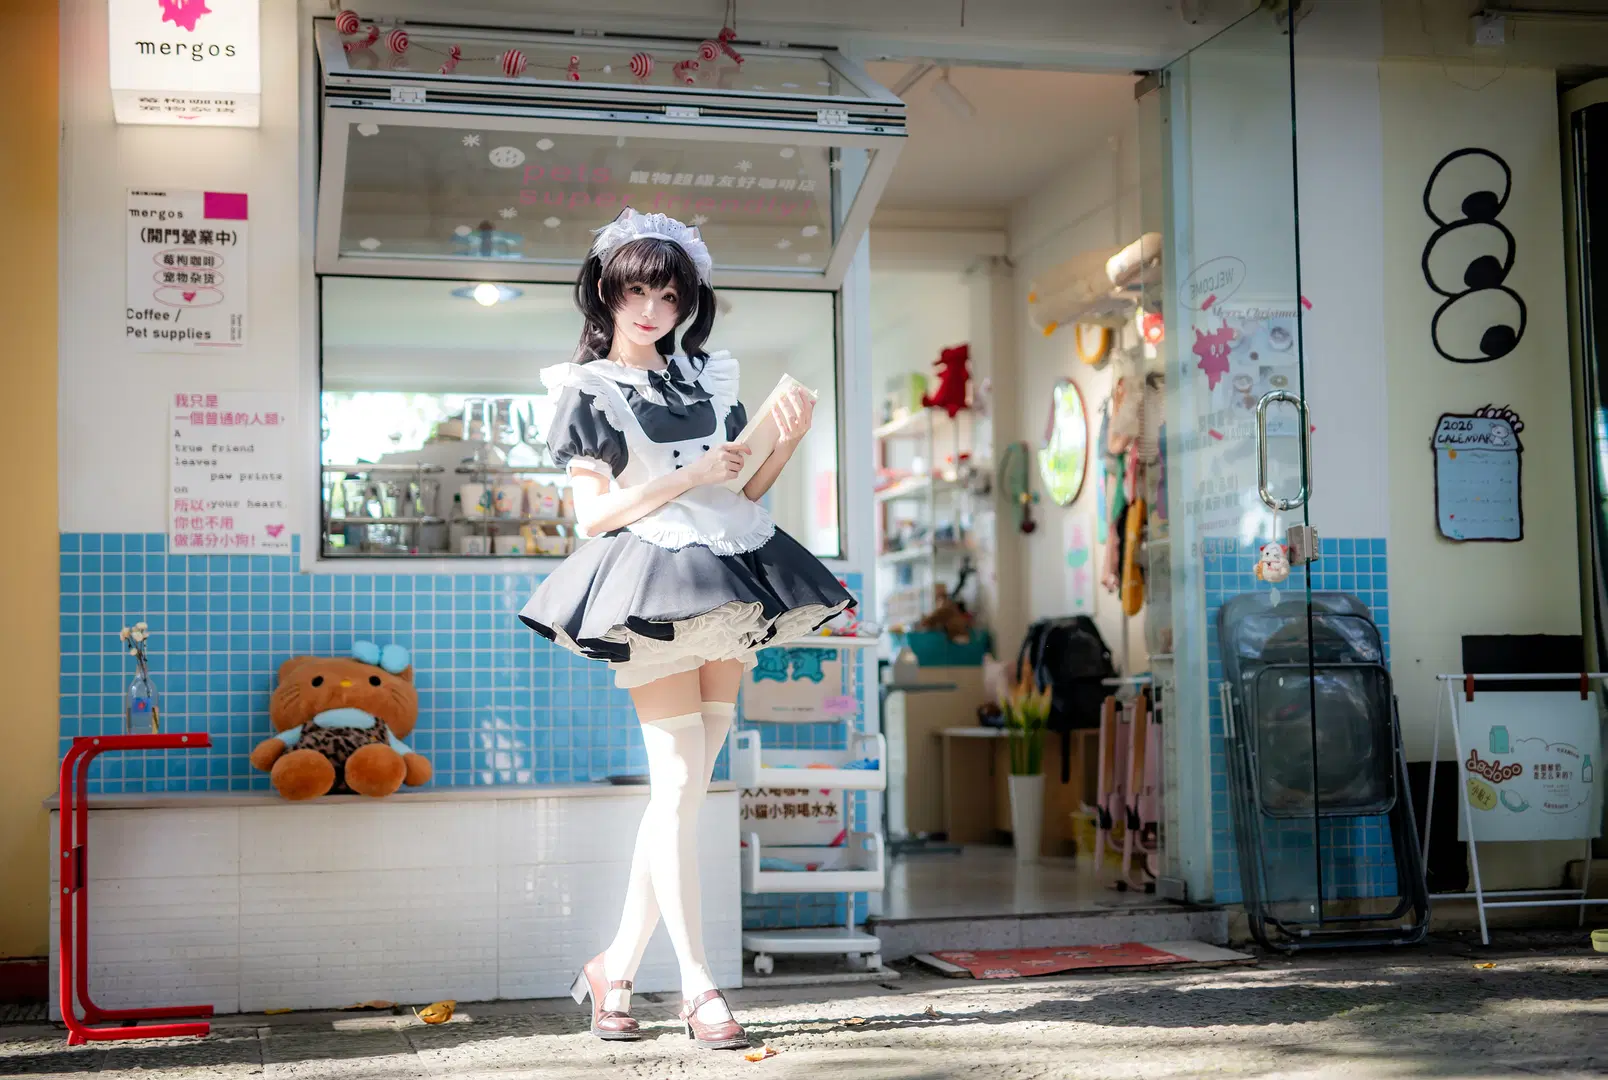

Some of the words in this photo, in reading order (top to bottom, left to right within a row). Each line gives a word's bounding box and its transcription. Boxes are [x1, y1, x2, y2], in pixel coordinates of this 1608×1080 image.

[135, 41, 236, 62] mergos
[519, 188, 636, 213] super
[652, 190, 813, 218] friendly!
[129, 208, 184, 221] mergos
[126, 308, 170, 321] Coffee
[126, 326, 148, 338] Pet
[152, 327, 212, 342] supplies
[174, 393, 218, 409] 我只是
[1443, 420, 1473, 431] 2026
[174, 429, 181, 438] A
[174, 444, 203, 453] true
[211, 443, 255, 453] friend
[174, 457, 218, 467] leaves
[210, 472, 233, 483] paw
[239, 471, 283, 483] prints
[174, 486, 189, 494] on
[210, 500, 240, 511] your
[174, 515, 234, 531] 你也不用
